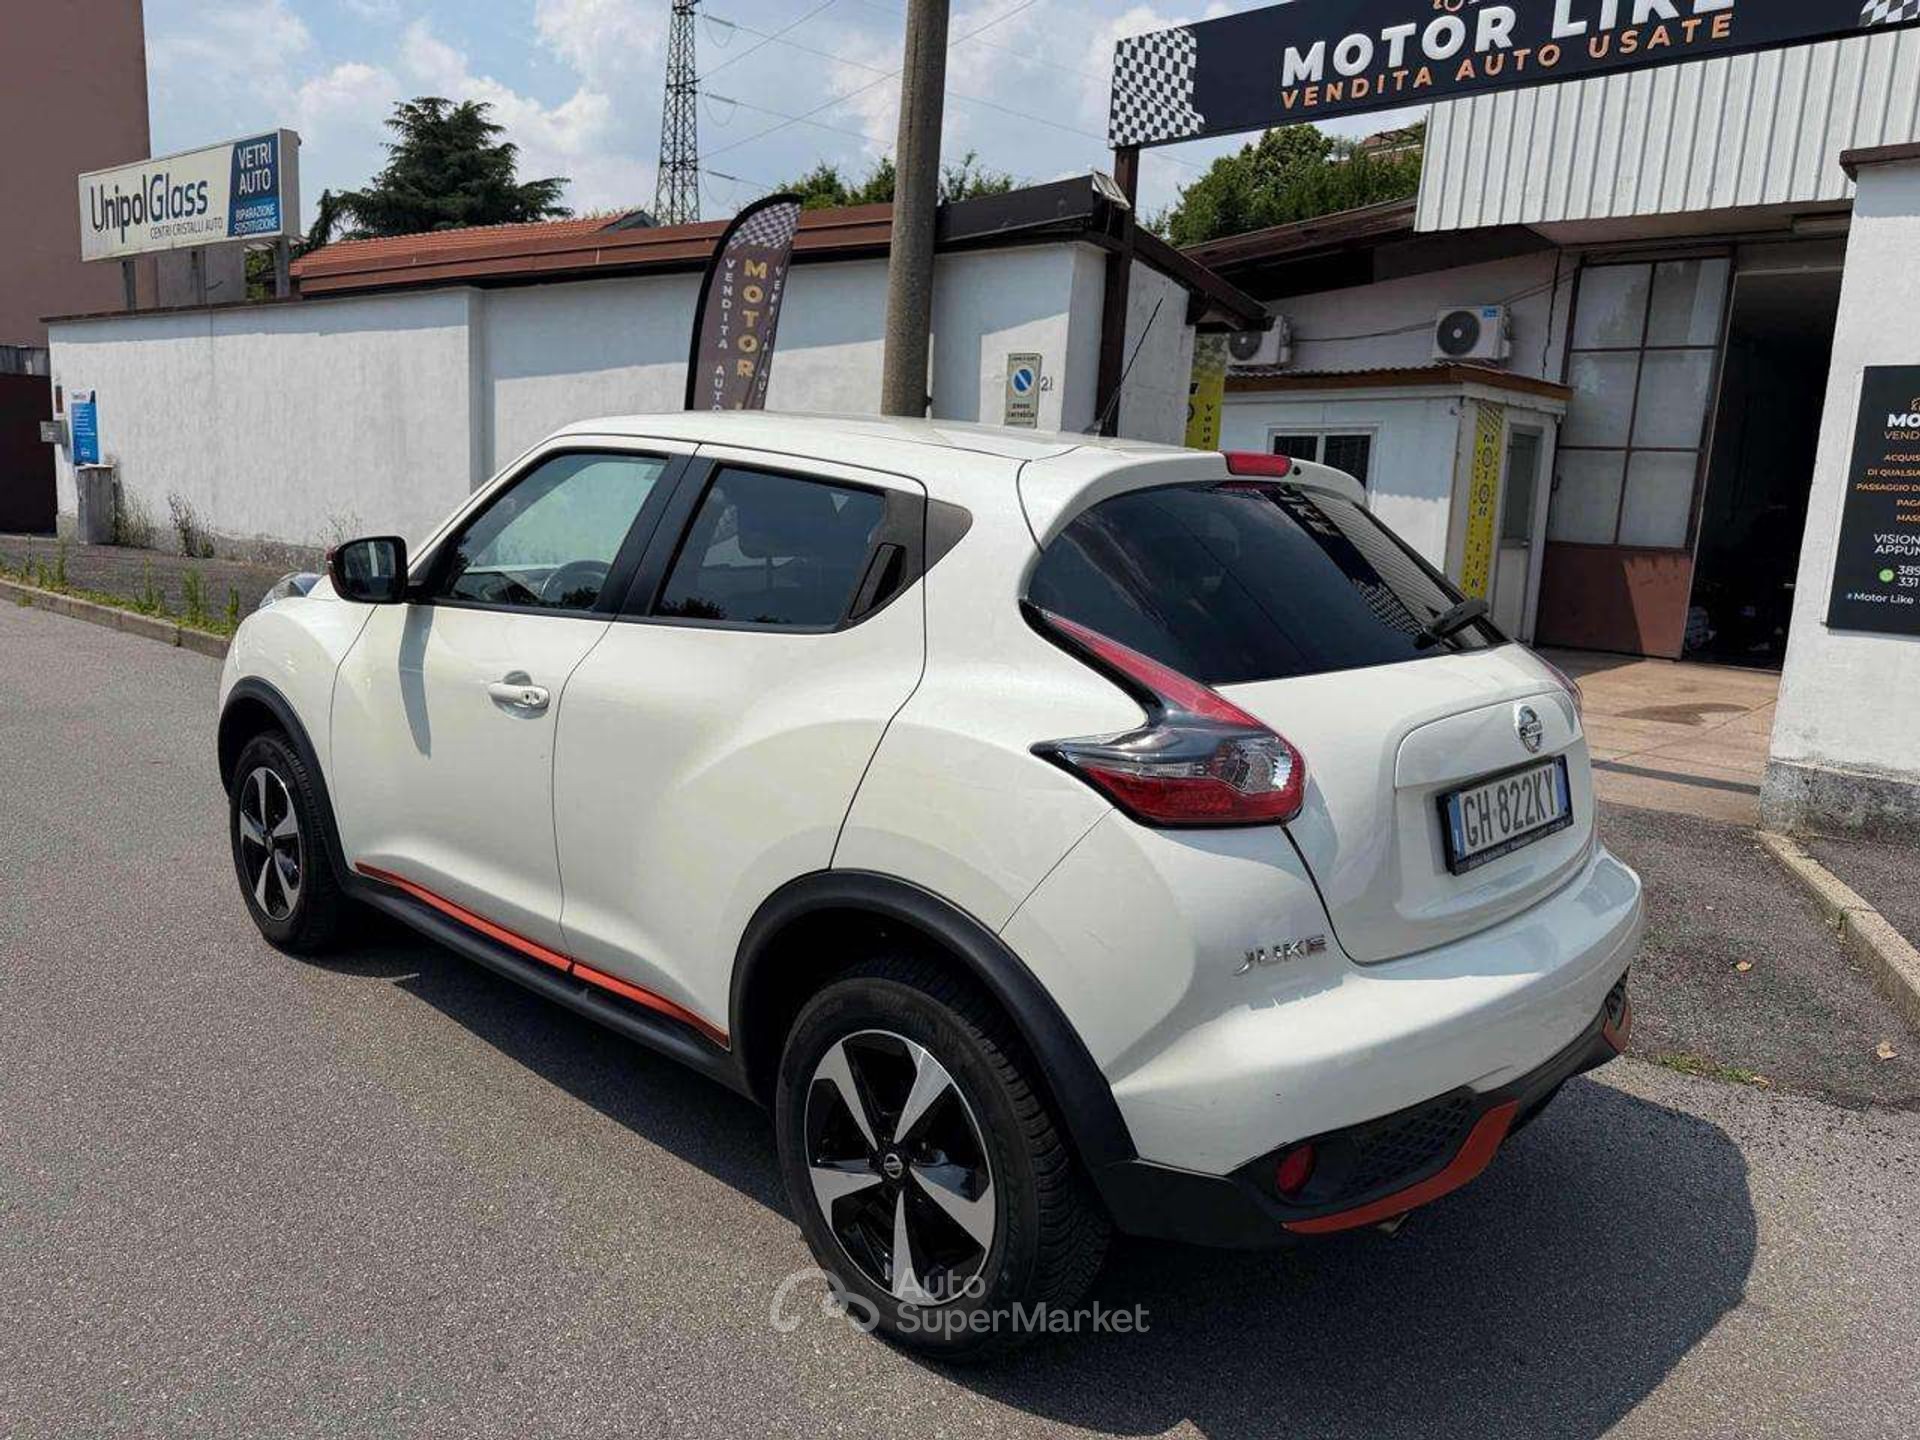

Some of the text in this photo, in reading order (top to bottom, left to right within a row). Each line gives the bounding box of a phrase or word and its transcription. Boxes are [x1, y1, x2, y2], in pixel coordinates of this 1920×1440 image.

[1281, 0, 1736, 87] MOTOR LIK
[1281, 13, 1733, 111] VENDITA AUTO USATE
[238, 141, 273, 169] VETRI
[238, 167, 272, 196] AUTO
[90, 172, 209, 244] UnipolGlass
[150, 223, 172, 240] CENTRI
[205, 216, 224, 233] AUTO
[718, 257, 736, 350] VENDITA
[736, 258, 768, 379] MOTOR
[1854, 592, 1888, 603] Motor
[1463, 788, 1493, 847] GH
[1497, 767, 1555, 835] 822KY
